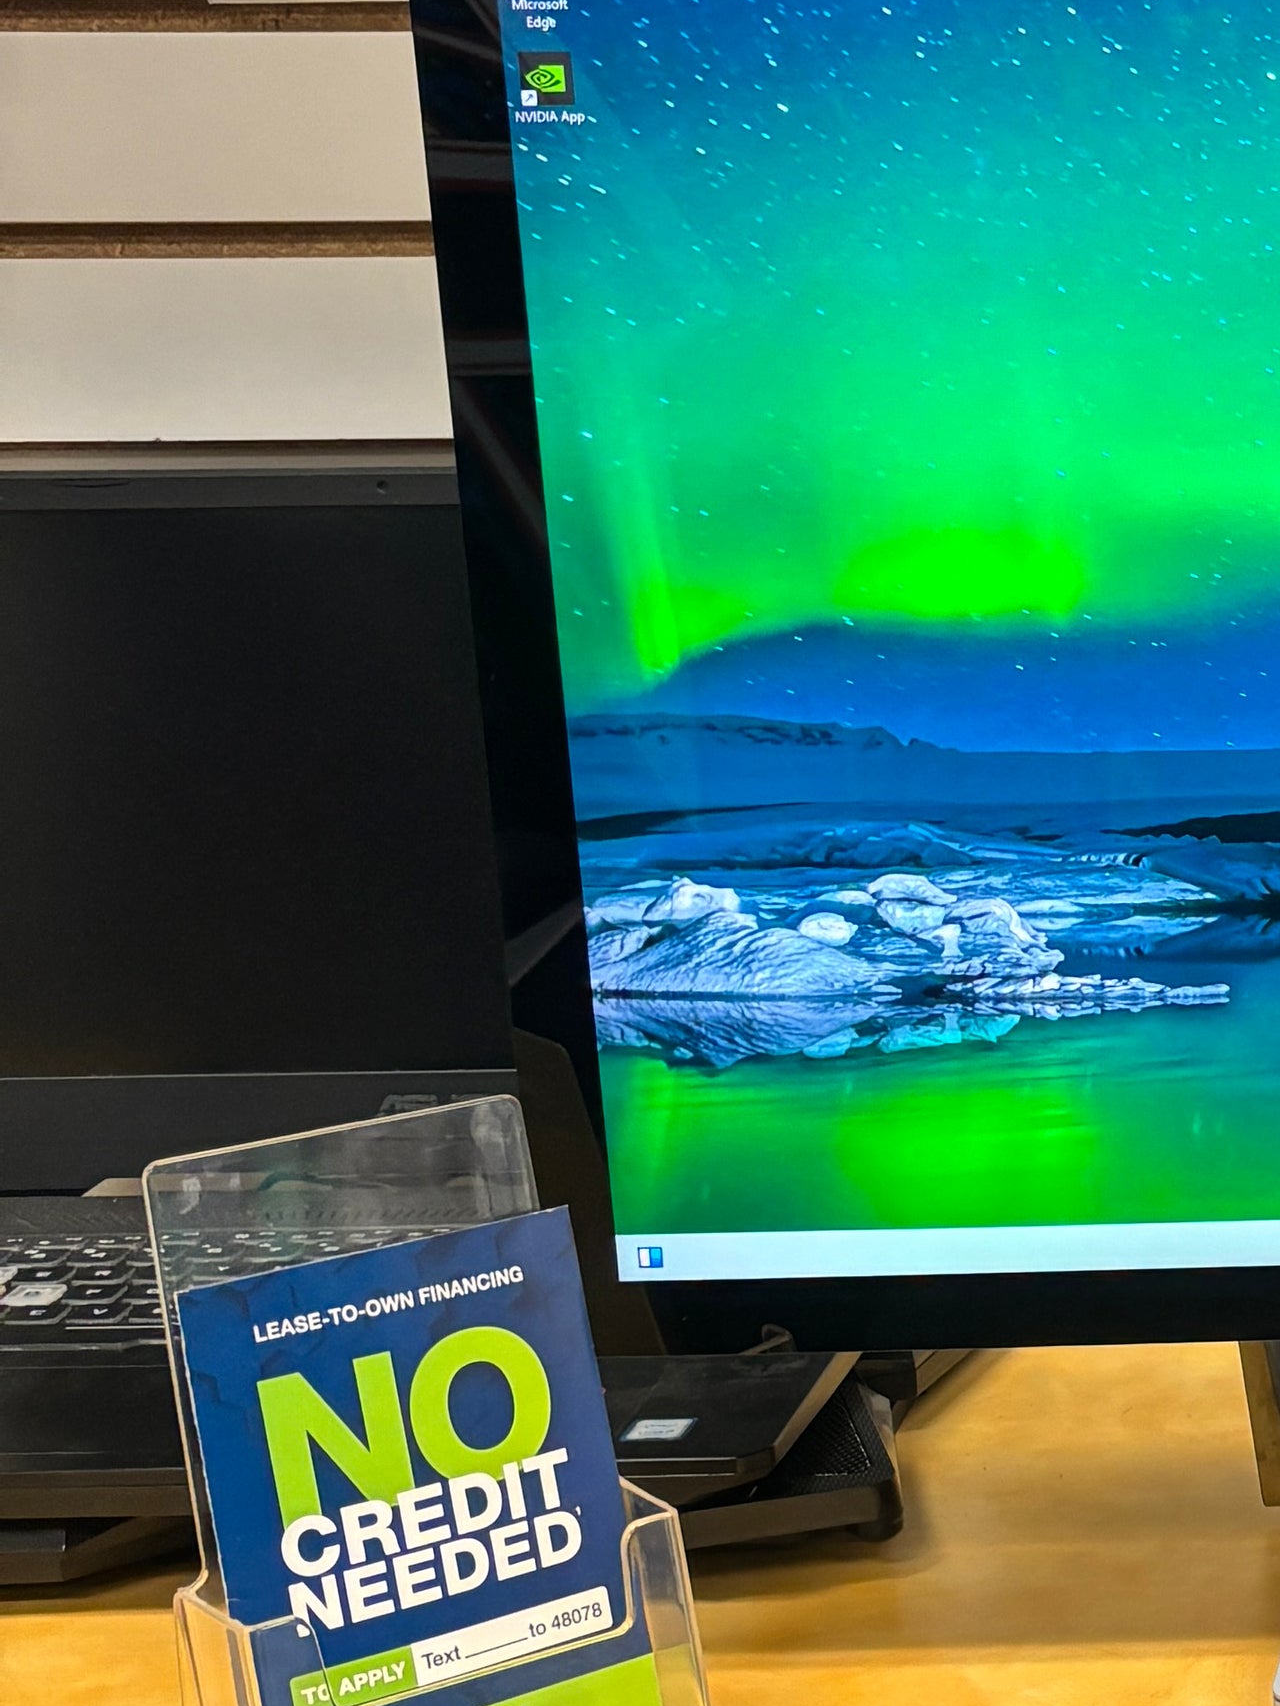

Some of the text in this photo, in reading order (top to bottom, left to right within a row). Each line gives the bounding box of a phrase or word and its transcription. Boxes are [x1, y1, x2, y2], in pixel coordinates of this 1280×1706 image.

[526, 15, 557, 30] Edge
[515, 110, 586, 127] NVIDIA App
[253, 1265, 524, 1343] LEASE-TO-OWN FINANCING
[257, 1325, 551, 1531] NO
[281, 1447, 568, 1577] CREDIT
[339, 1660, 406, 1697] APPLY
[421, 1645, 463, 1670] Text
[528, 1622, 547, 1639] to
[551, 1602, 603, 1631] 48078
